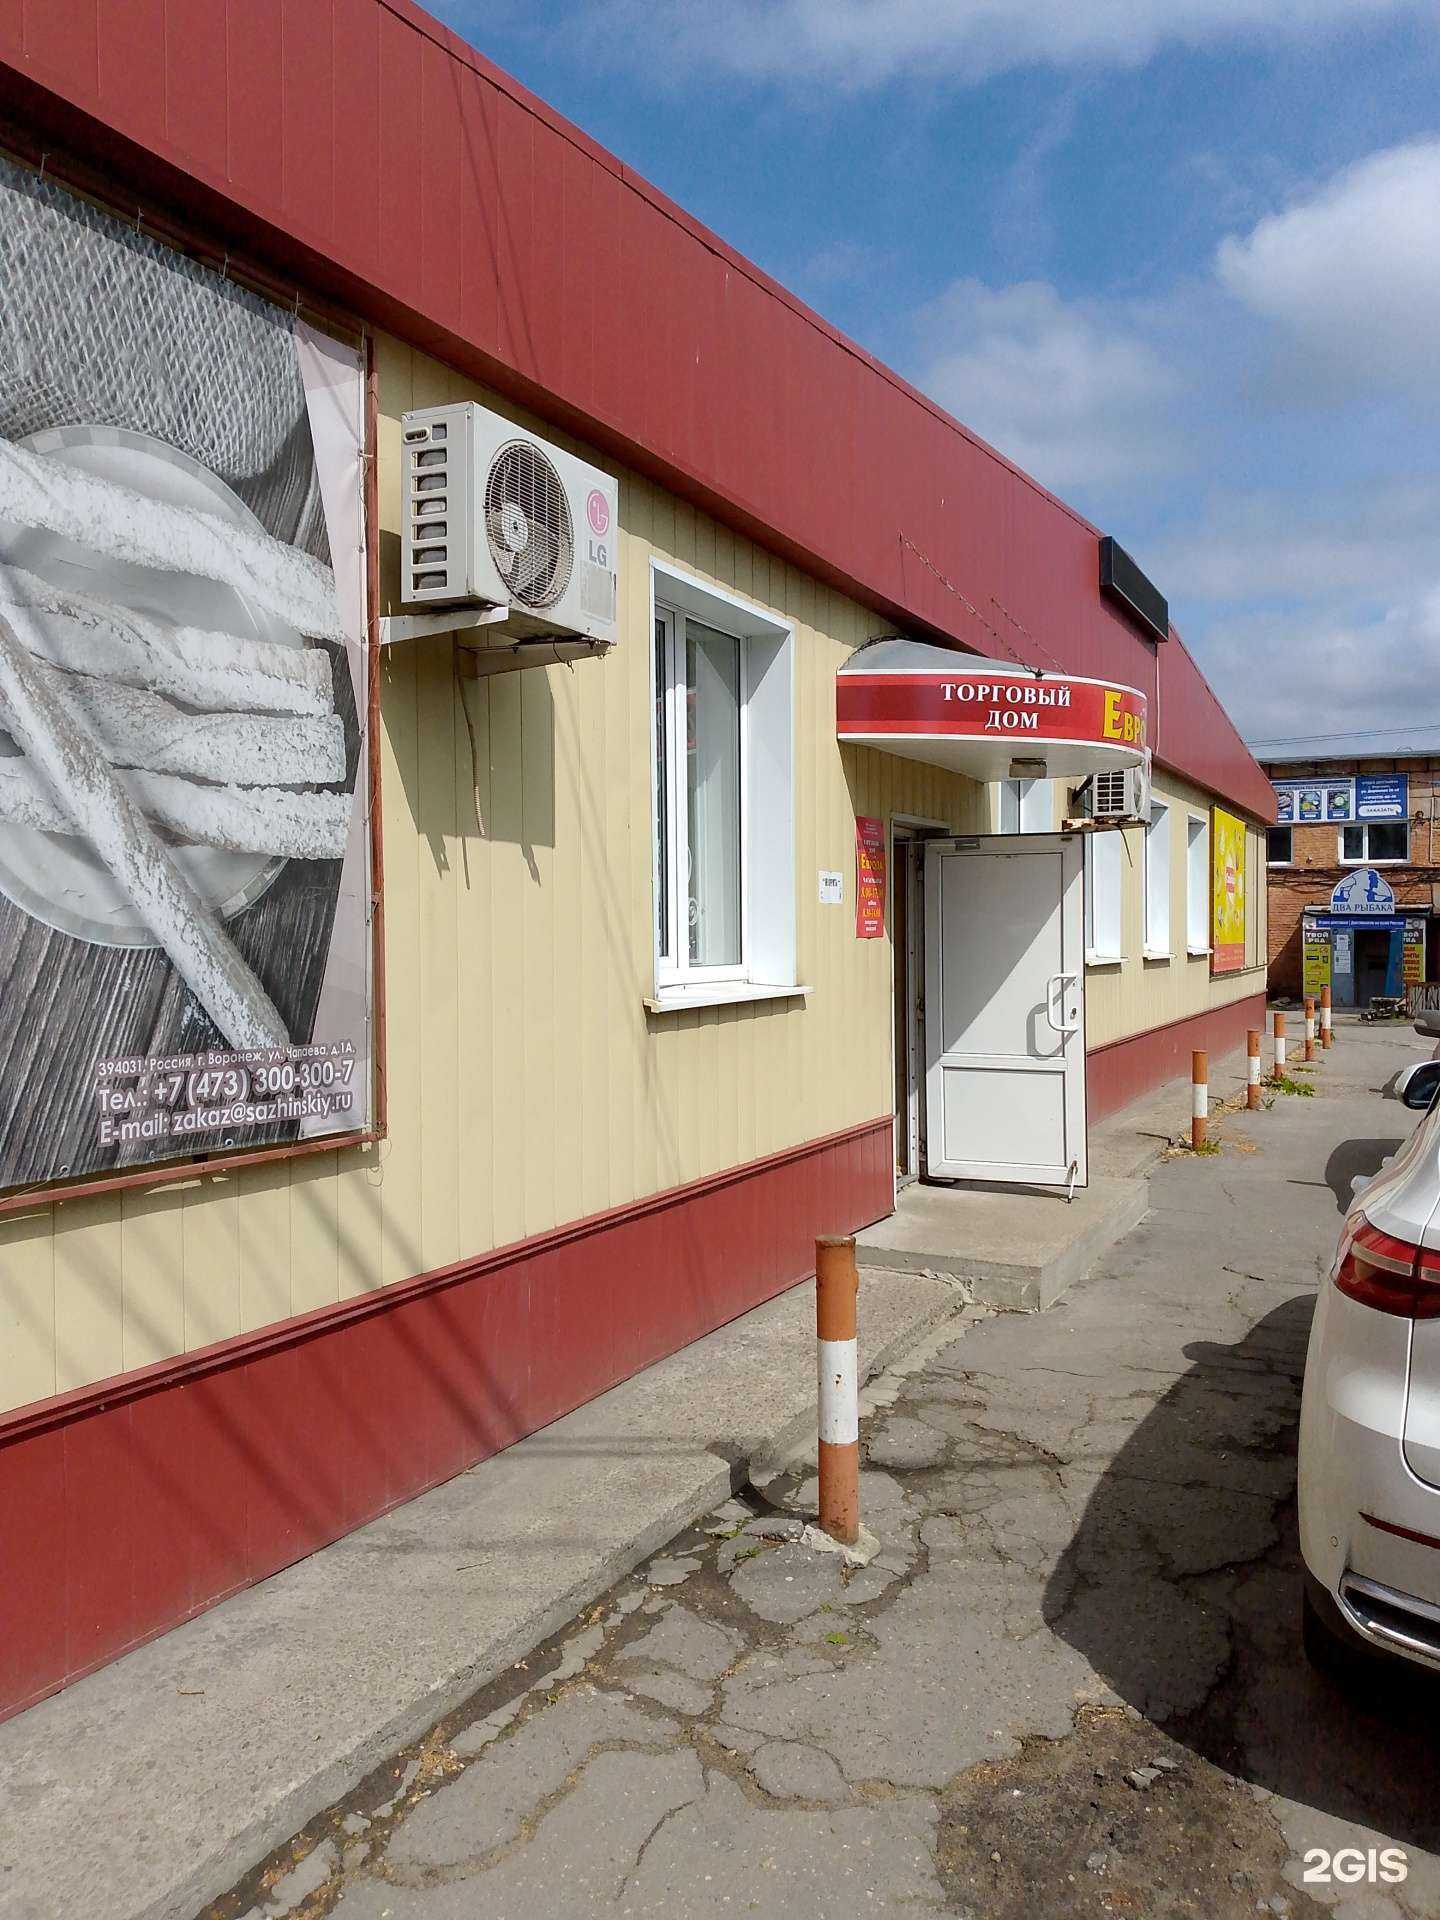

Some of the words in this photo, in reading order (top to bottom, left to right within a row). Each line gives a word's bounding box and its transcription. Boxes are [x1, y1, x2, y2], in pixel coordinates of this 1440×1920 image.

[589, 540, 607, 567] LG
[941, 683, 1071, 707] ТОРГОВЫЙ
[984, 710, 1039, 731] ДОМ
[1332, 904, 1352, 913] ДВА
[1354, 904, 1393, 913] РЫБАКА
[98, 1060, 146, 1077] 394031,
[150, 1057, 194, 1072] Россия,
[198, 1056, 206, 1066] г.
[208, 1050, 265, 1066] Воронеж,
[268, 1048, 283, 1064] ул.
[154, 1075, 183, 1105] +7
[188, 1070, 249, 1105] (473)
[255, 1060, 354, 1093] 300-300-7
[101, 1113, 168, 1143] E-mail:
[173, 1094, 351, 1132] zakaz@sazhinskiy.ru
